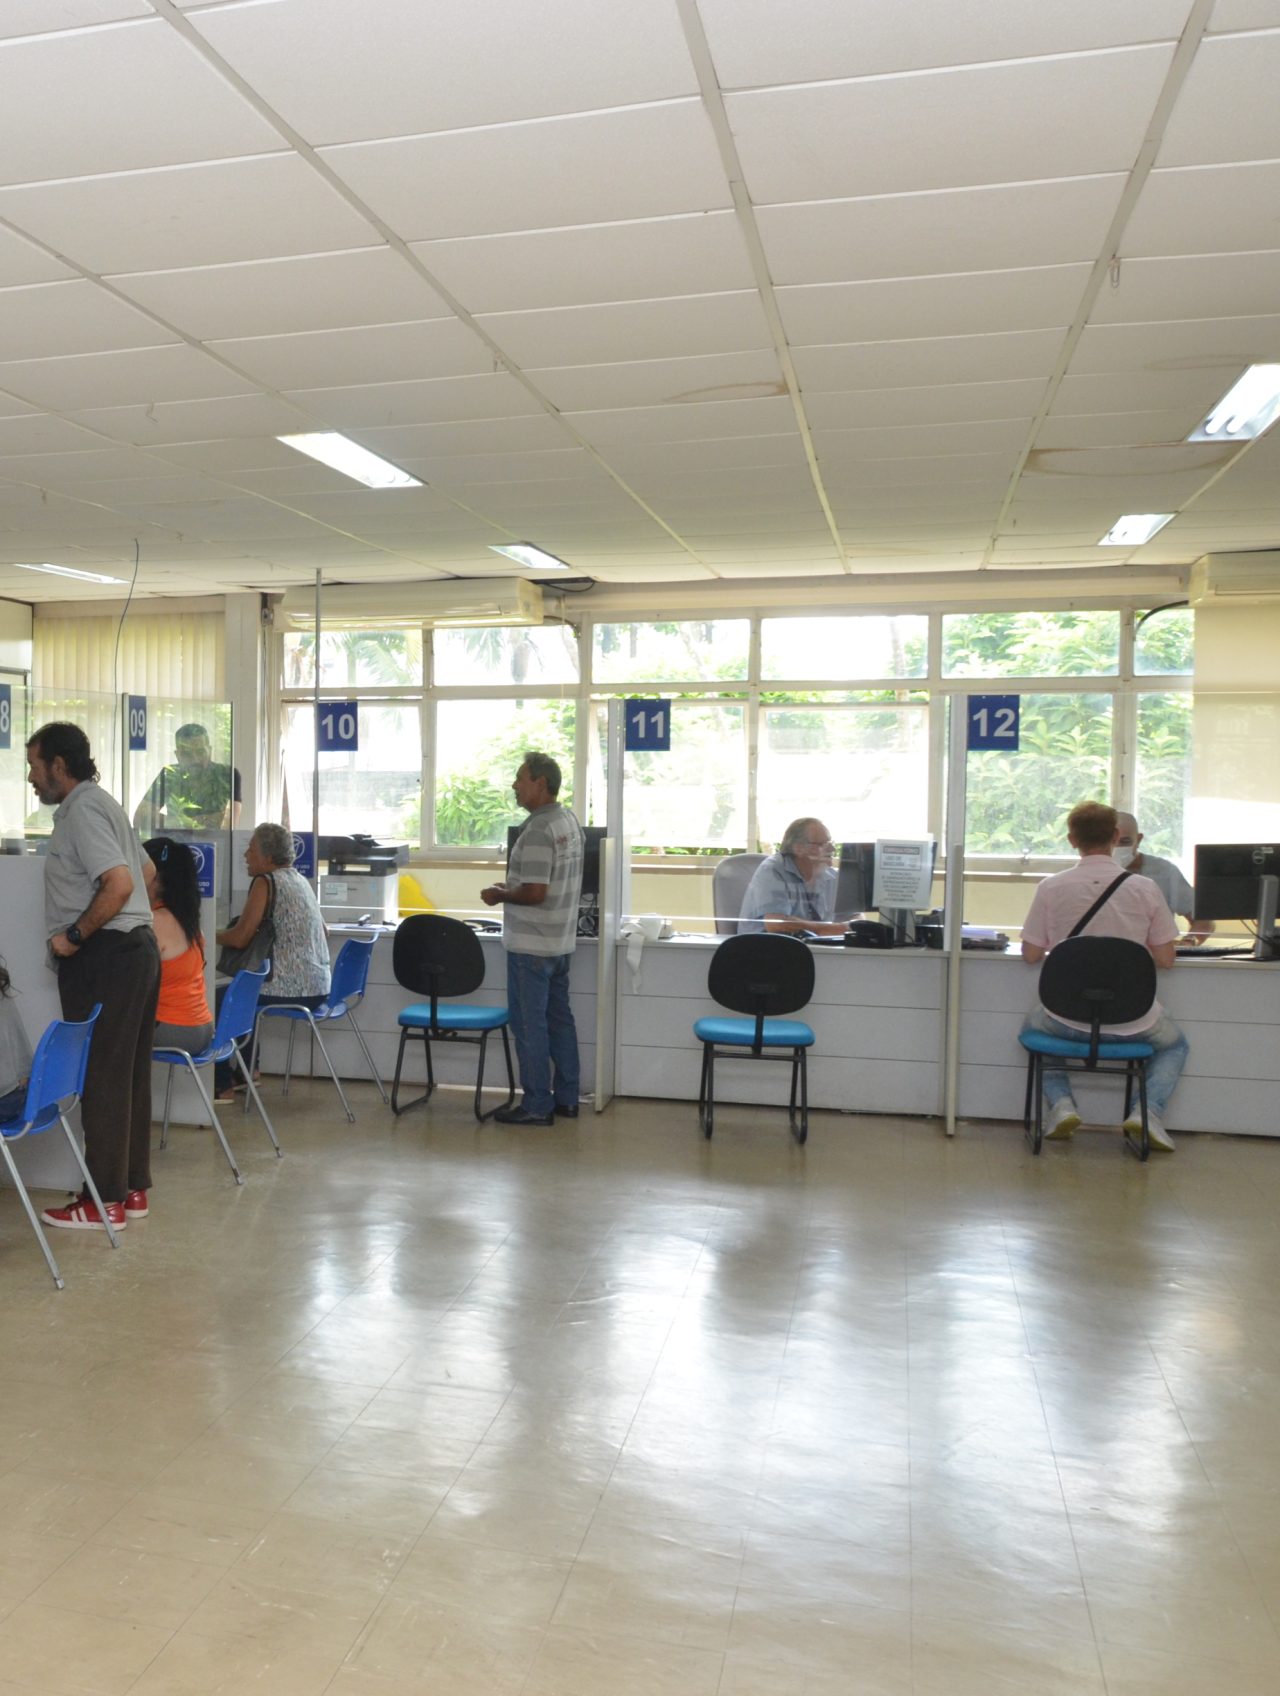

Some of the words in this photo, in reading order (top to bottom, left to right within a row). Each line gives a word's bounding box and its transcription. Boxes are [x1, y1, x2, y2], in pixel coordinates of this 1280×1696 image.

[130, 708, 145, 737] 09
[322, 713, 355, 740] 10
[632, 711, 664, 738] 11
[973, 708, 1015, 737] 12
